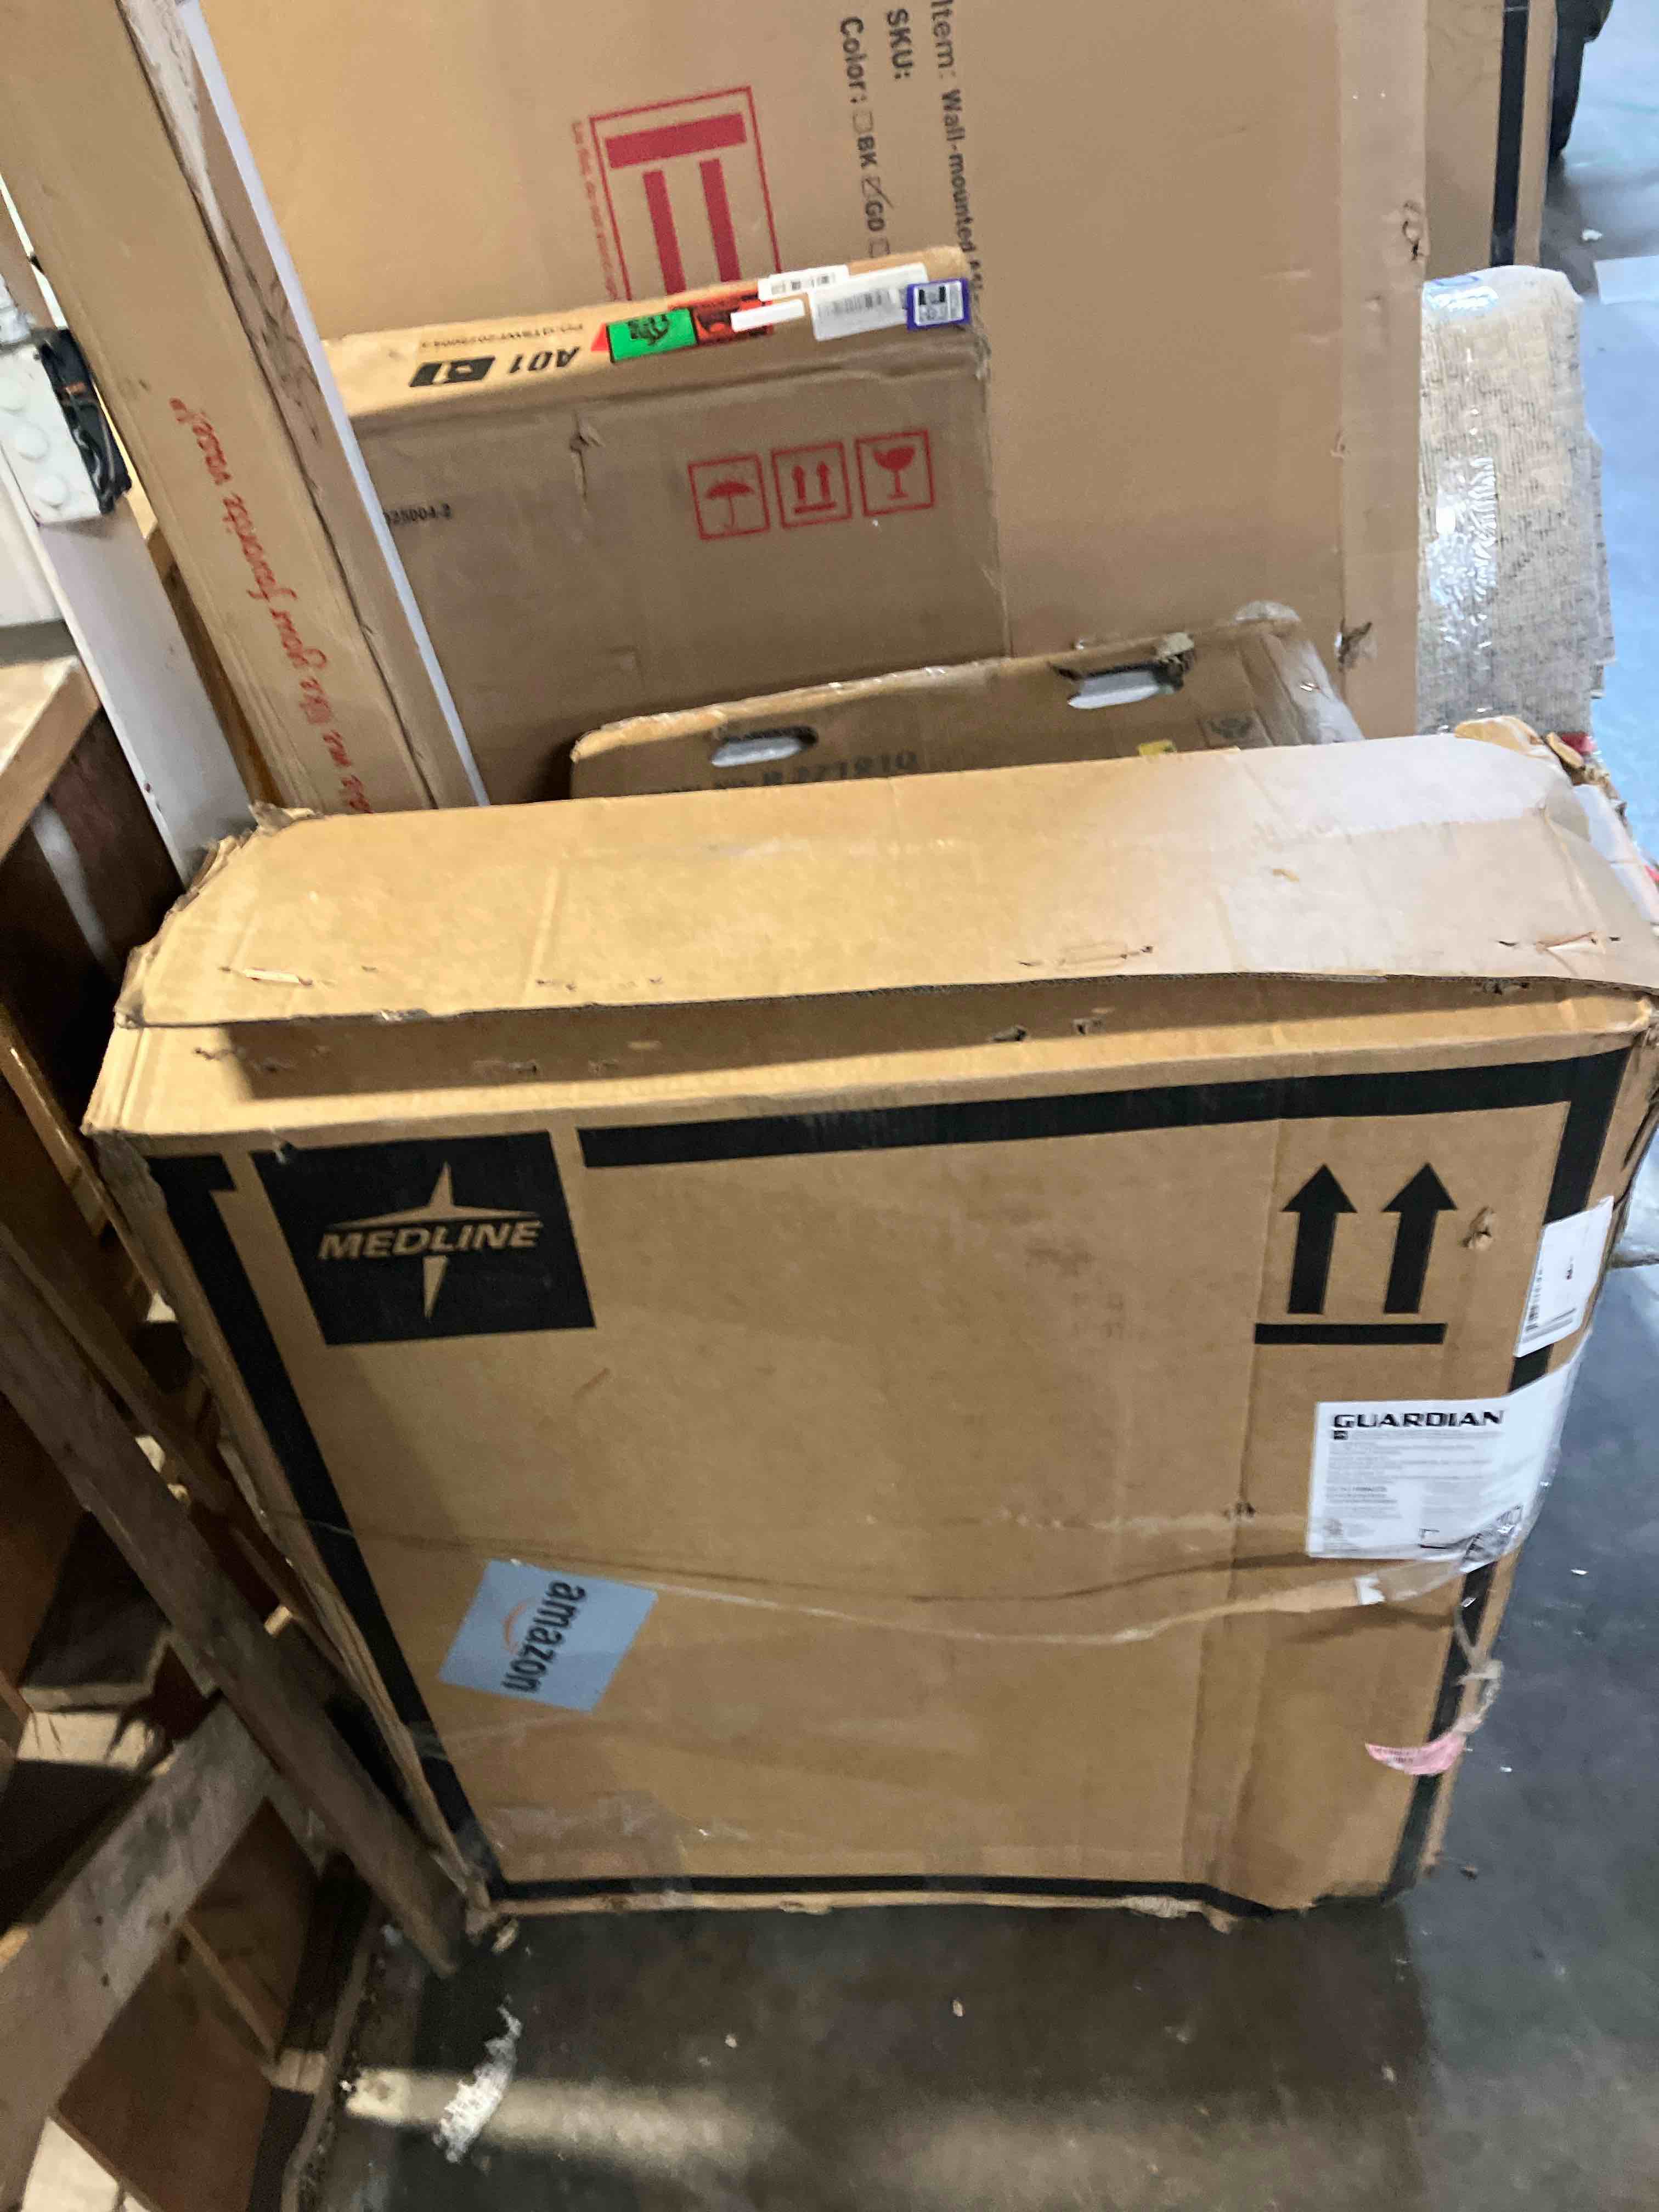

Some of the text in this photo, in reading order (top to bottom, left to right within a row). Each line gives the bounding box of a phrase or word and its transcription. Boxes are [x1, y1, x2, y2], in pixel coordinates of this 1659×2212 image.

[885, 8, 913, 80] SKU:
[839, 15, 867, 104] Color:
[857, 135, 878, 169] BK
[940, 88, 977, 252] Wall-mounted
[509, 345, 582, 374] A01
[221, 493, 298, 602] favorite
[269, 607, 328, 669] your
[317, 1220, 543, 1260] MEDLINE
[1334, 1409, 1504, 1428] GUARDIAN
[501, 1581, 586, 1694] amazon
